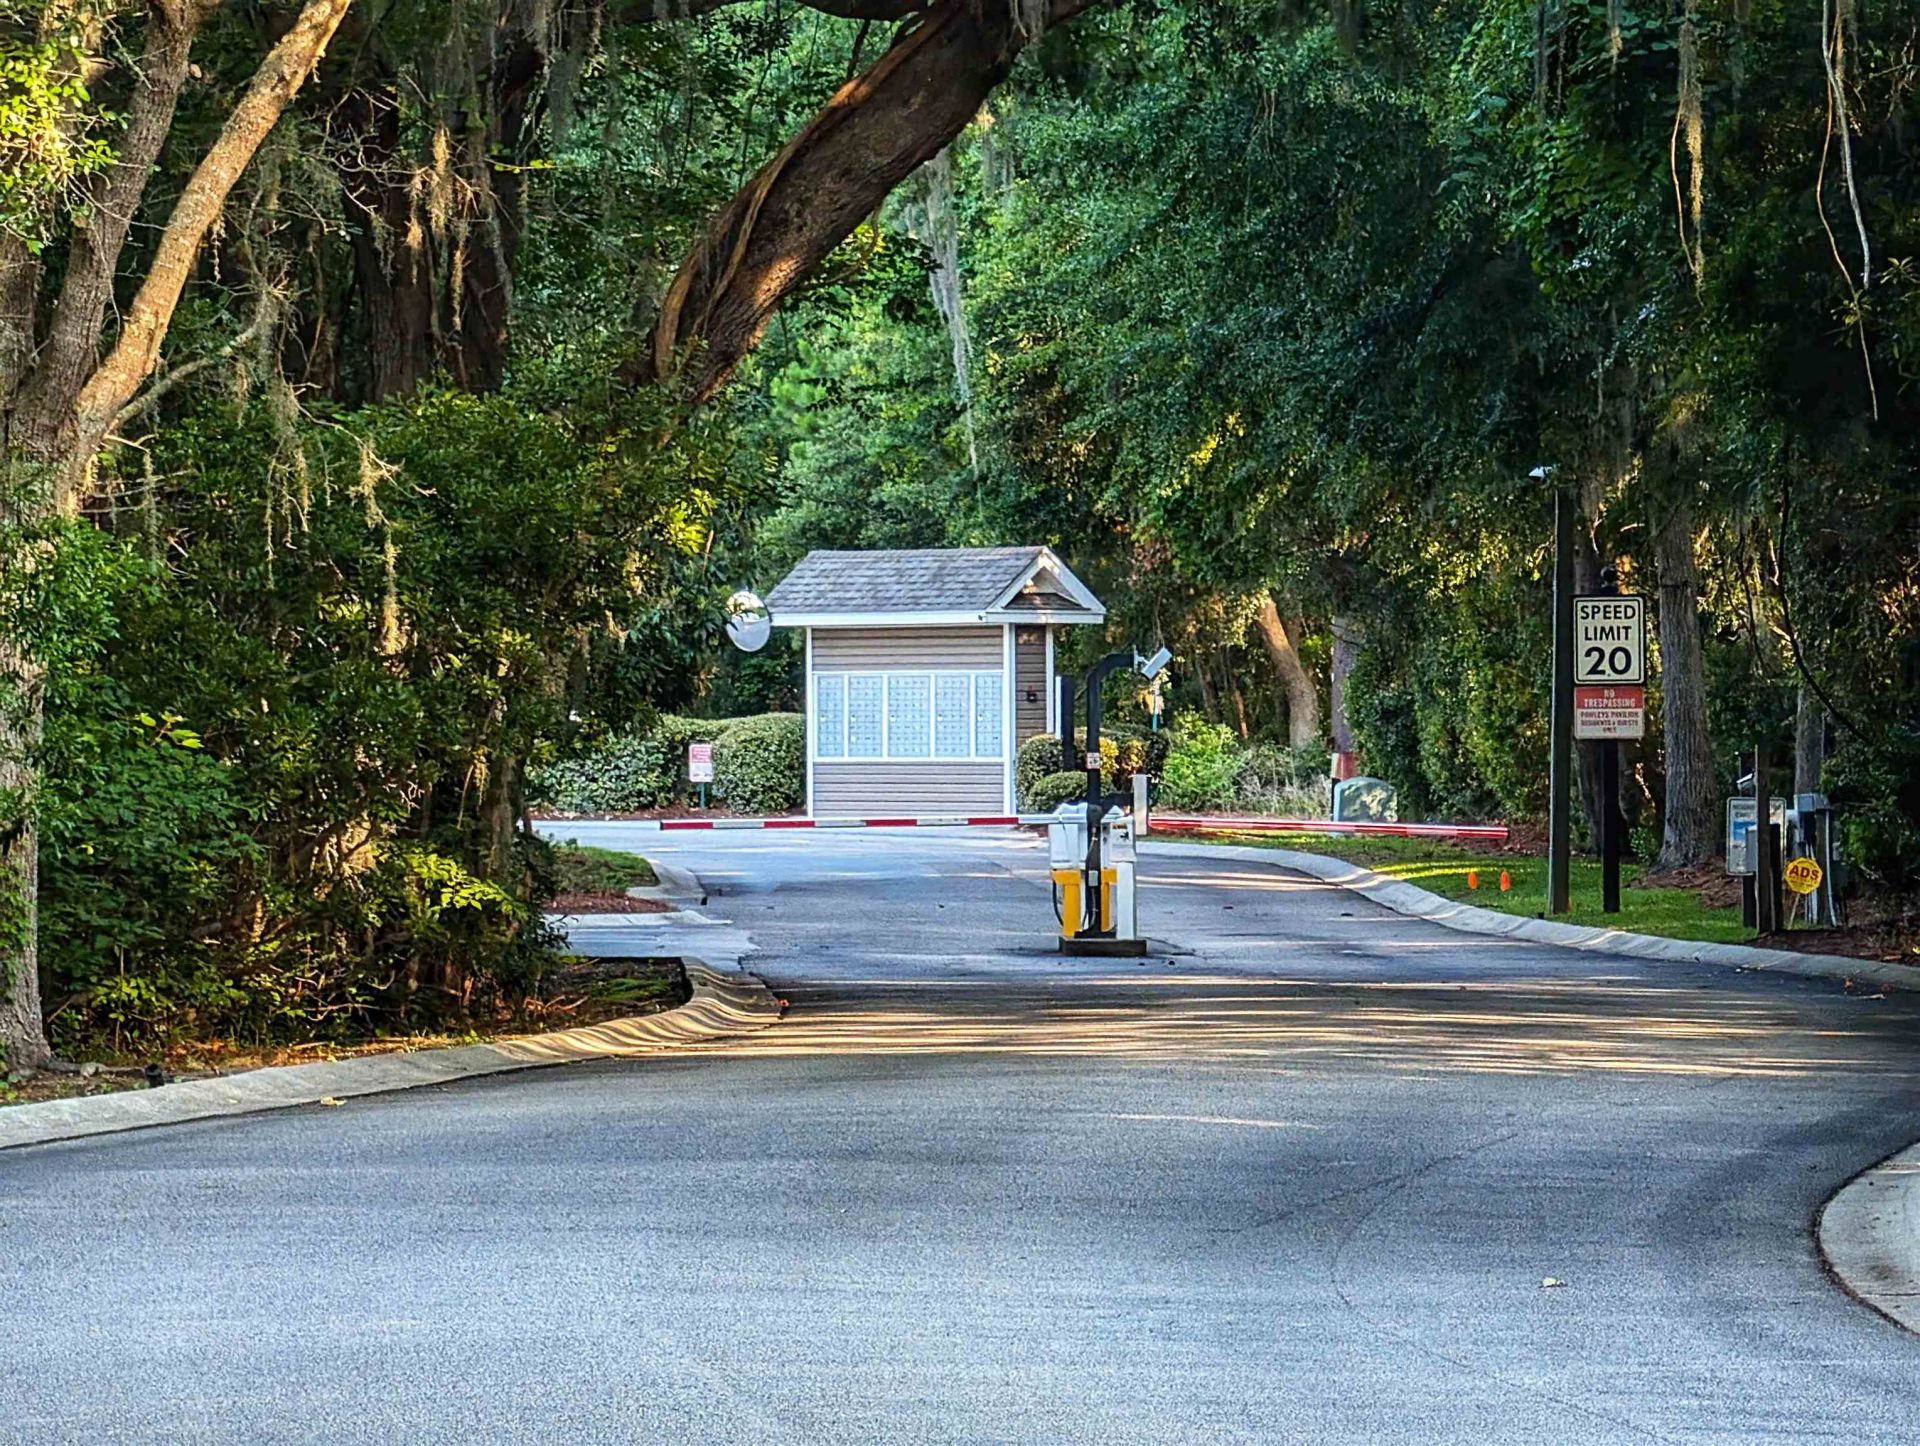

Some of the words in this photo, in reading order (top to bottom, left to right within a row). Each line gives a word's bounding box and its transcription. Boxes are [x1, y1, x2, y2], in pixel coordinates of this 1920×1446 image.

[1580, 604, 1636, 620] SPEED
[1584, 625, 1632, 641] LIMIT
[1584, 646, 1632, 675] 20
[1603, 689, 1615, 698] NO
[1584, 698, 1636, 708] TRESPASSING
[1789, 864, 1820, 881] ADS
